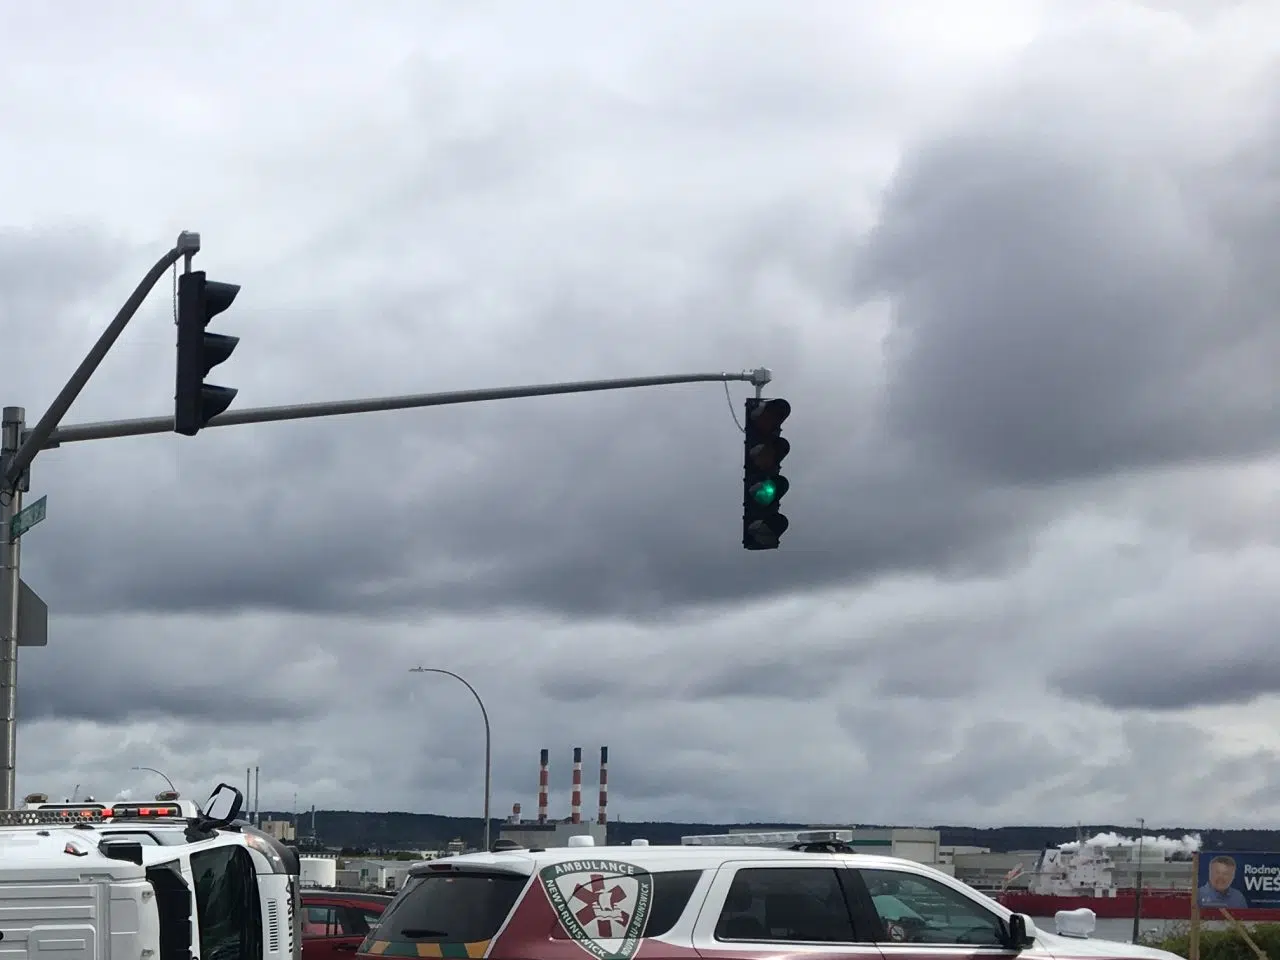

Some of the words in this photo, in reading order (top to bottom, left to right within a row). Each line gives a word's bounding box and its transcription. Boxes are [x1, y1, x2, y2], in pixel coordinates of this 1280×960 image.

[555, 861, 635, 875] AMBULANCE
[546, 880, 562, 905] NEW
[558, 904, 607, 957] BRUNSWICK
